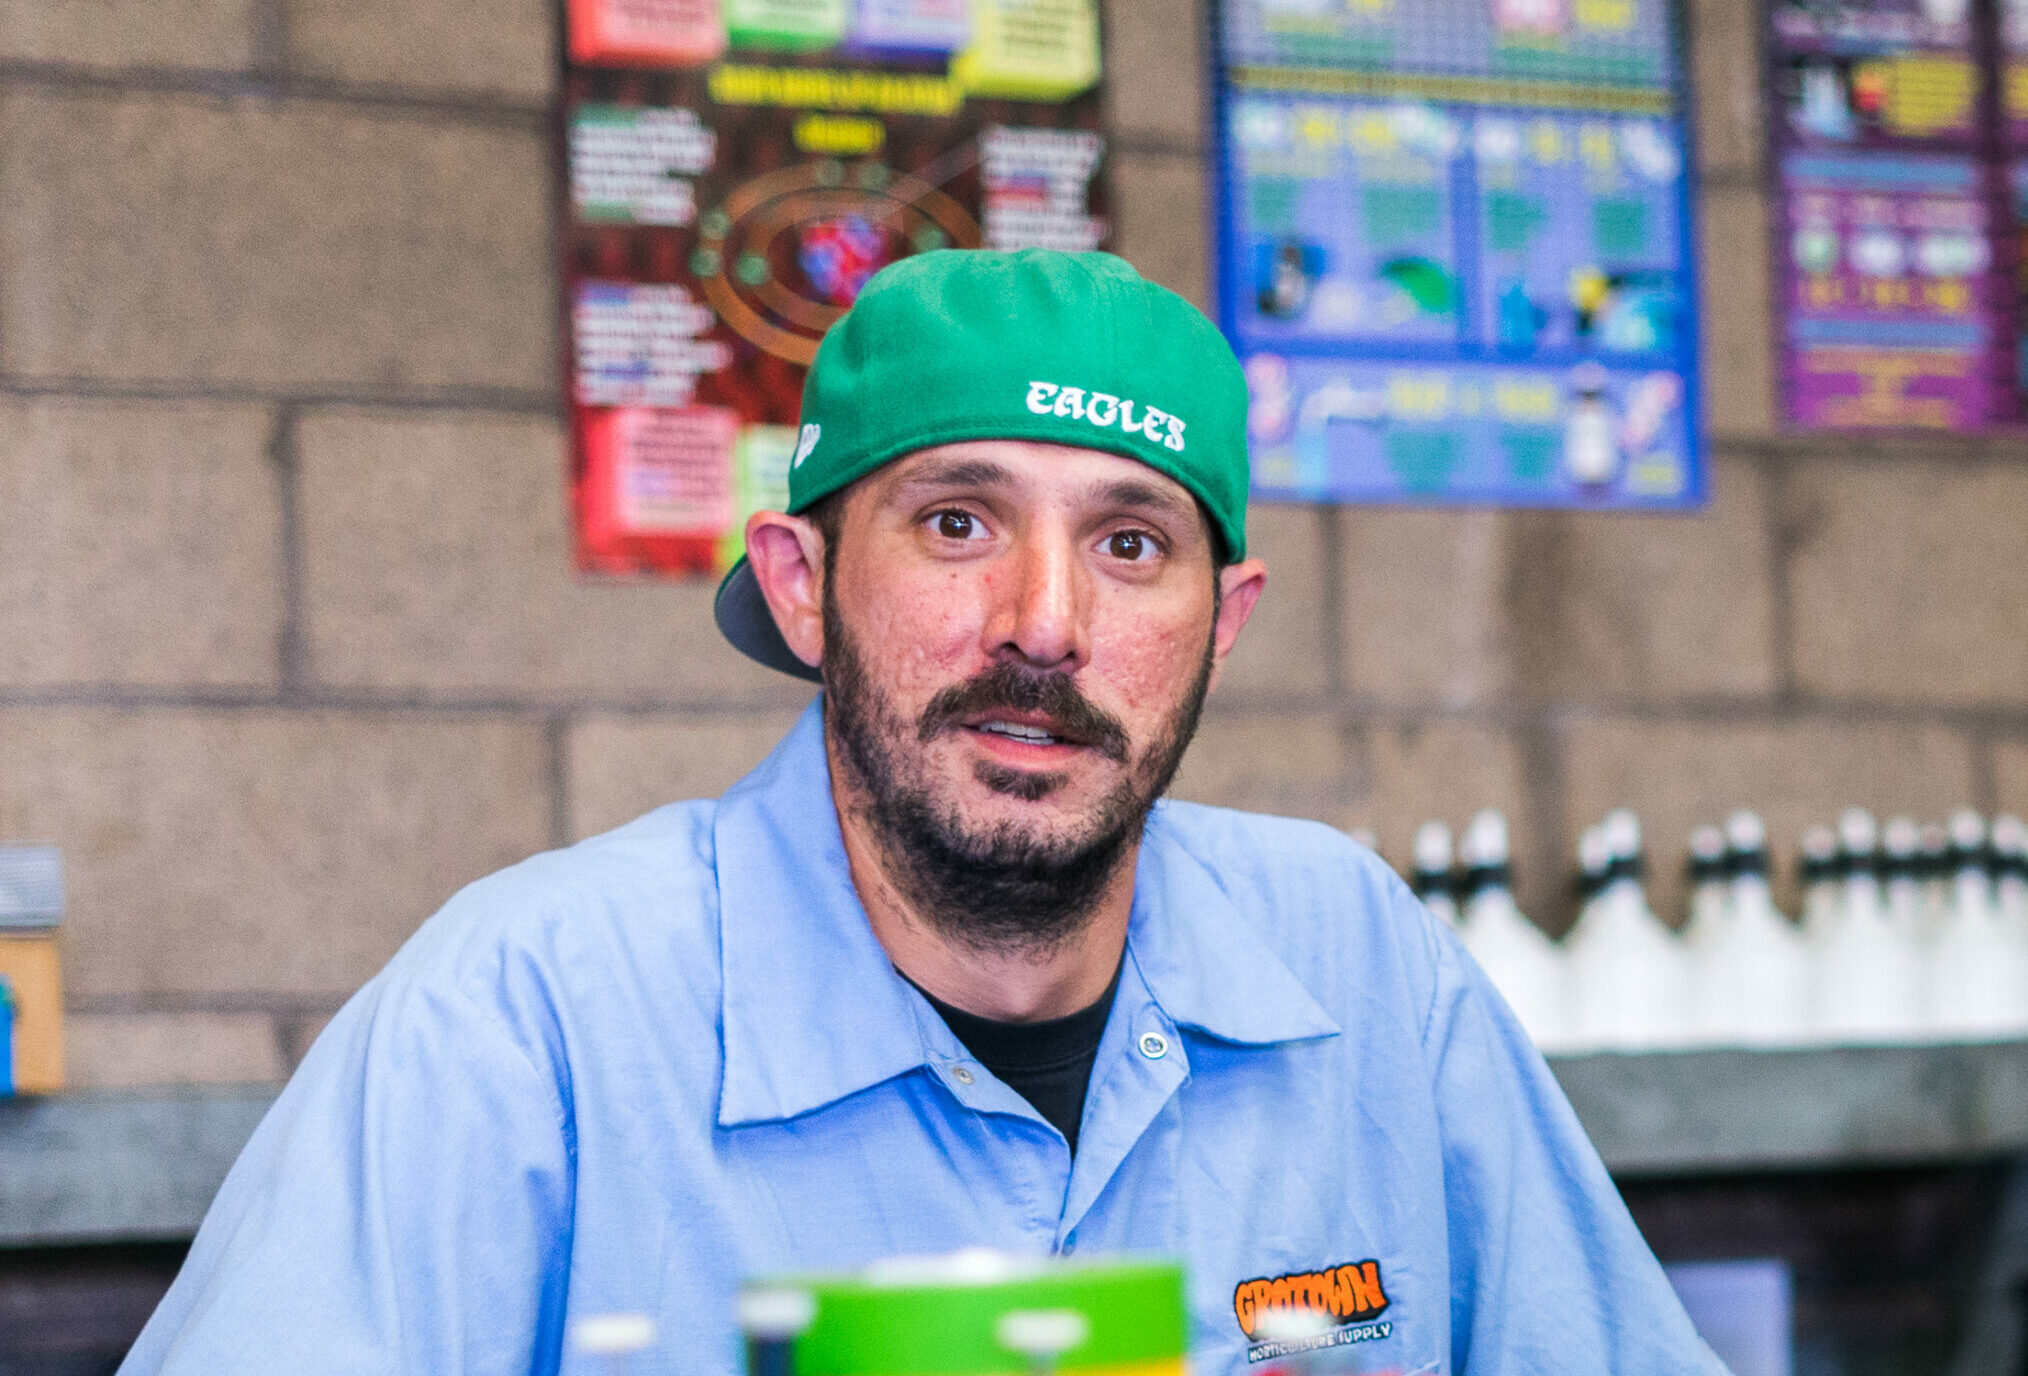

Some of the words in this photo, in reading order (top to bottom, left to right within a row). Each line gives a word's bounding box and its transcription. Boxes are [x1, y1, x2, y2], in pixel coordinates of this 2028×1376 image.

[1026, 381, 1186, 451] EAGLES
[1235, 1260, 1388, 1337] GROTOWN
[1338, 1322, 1392, 1345] SUPPLY
